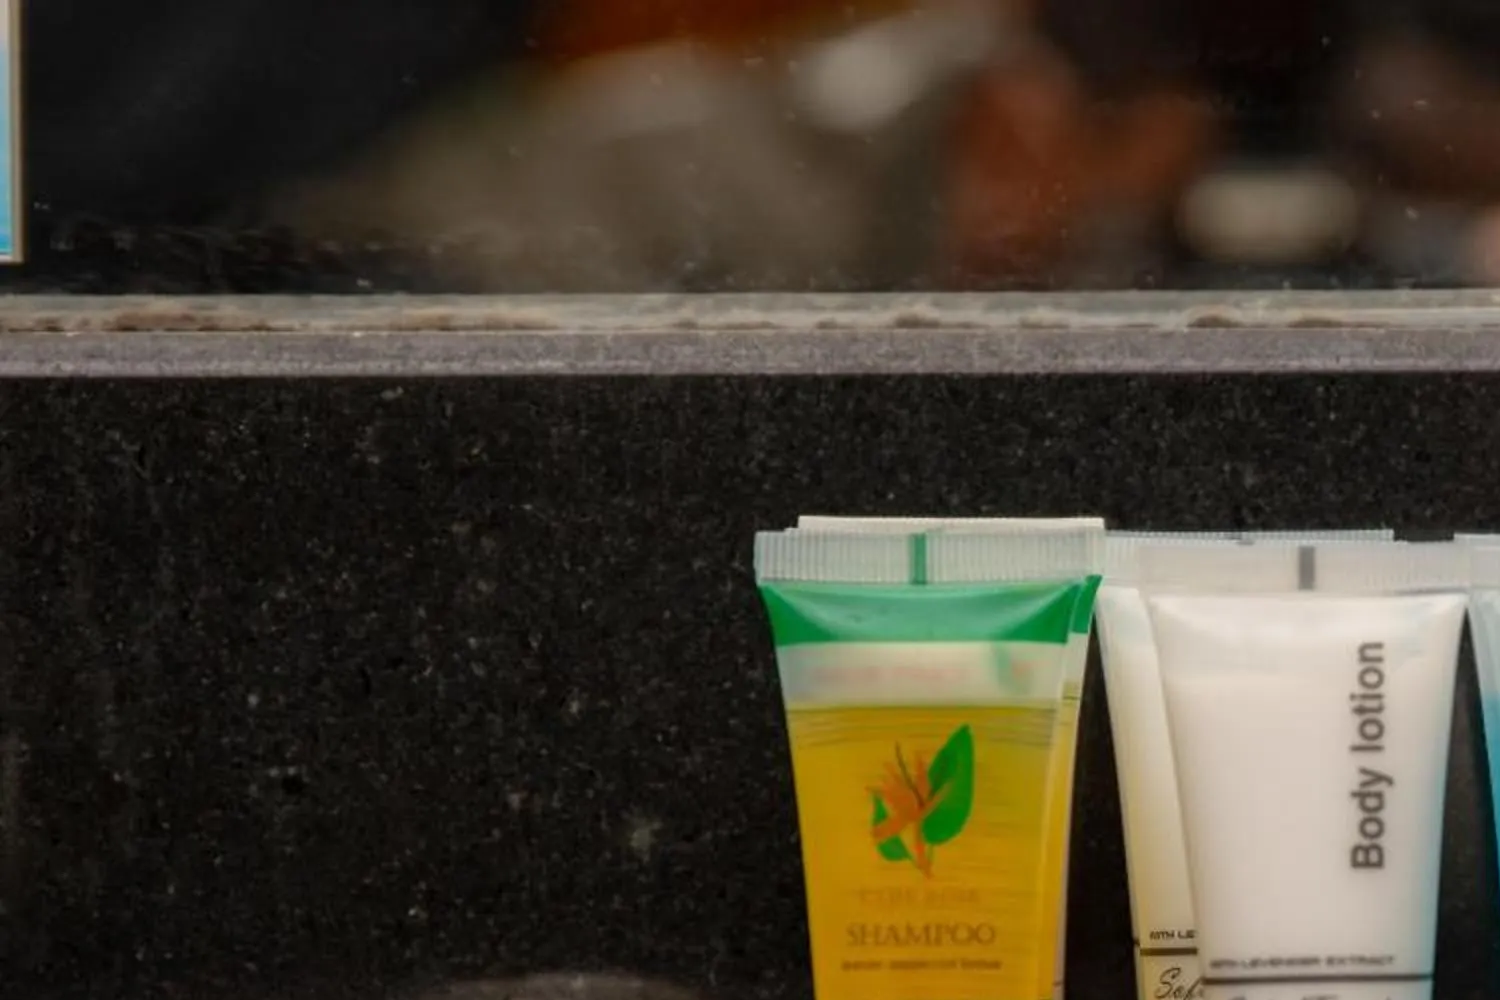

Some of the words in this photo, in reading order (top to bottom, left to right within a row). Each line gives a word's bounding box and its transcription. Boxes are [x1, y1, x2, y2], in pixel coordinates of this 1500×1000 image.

[1350, 641, 1385, 752] lotion
[1350, 767, 1393, 869] Body
[846, 922, 996, 946] SHAMPOO
